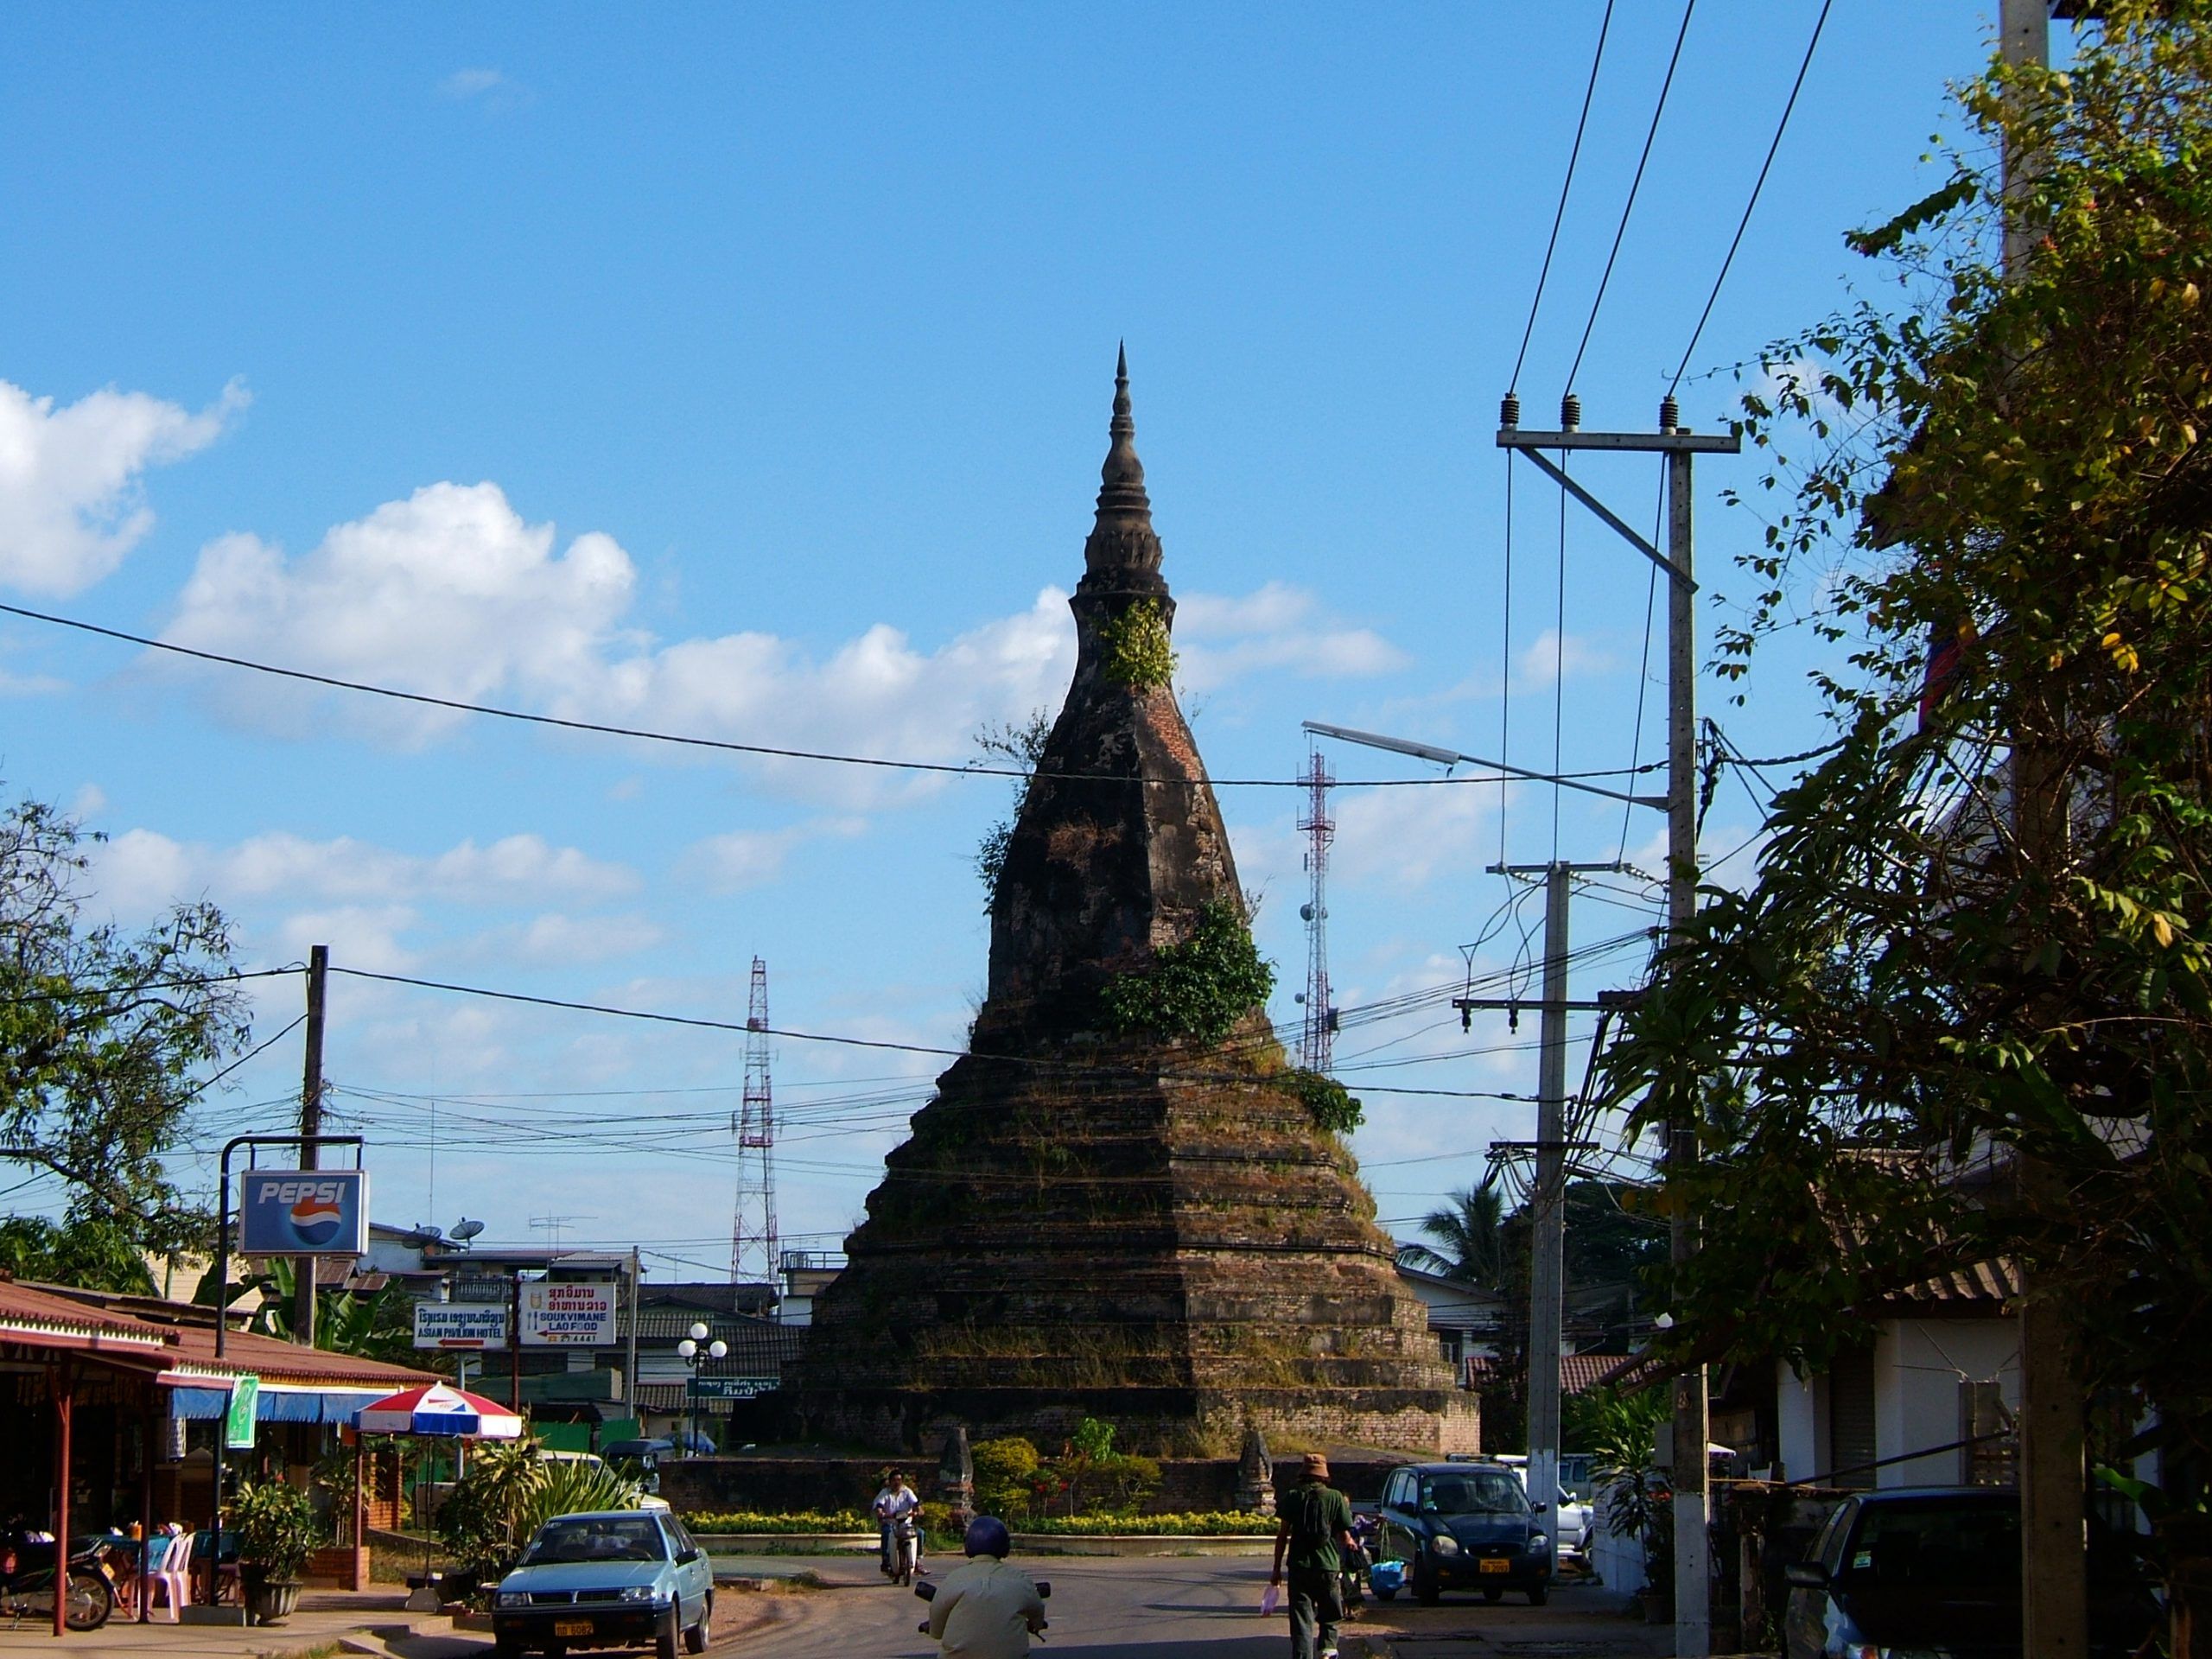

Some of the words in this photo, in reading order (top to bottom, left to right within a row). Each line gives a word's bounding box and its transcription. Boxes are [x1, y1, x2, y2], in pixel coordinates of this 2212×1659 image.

[258, 1182, 346, 1204] PEPSI
[540, 1313, 607, 1321] SOUKVIMANE
[549, 1322, 569, 1331] LAO
[418, 1327, 442, 1338] ASIAN
[444, 1327, 475, 1338] PAVILION
[477, 1327, 503, 1338] HOTEL
